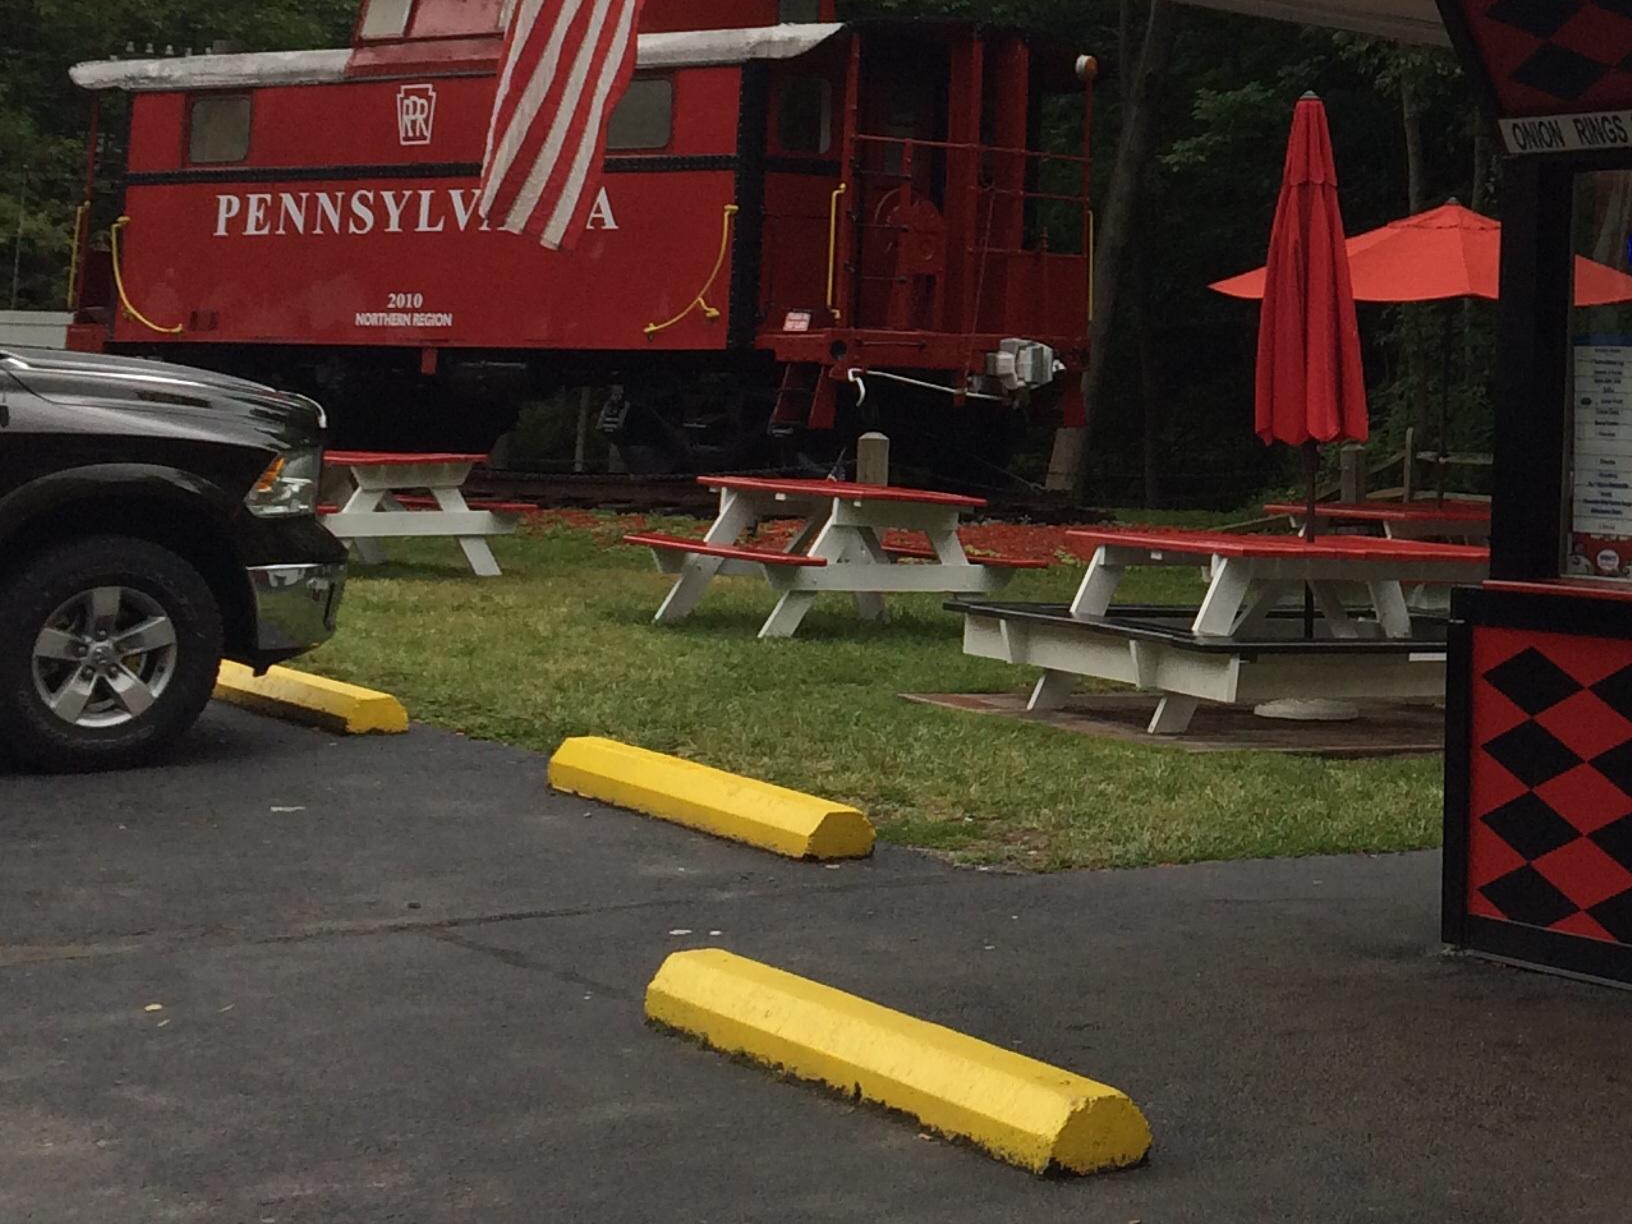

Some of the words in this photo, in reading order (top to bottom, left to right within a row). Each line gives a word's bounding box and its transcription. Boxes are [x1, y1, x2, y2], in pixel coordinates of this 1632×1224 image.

[1512, 120, 1566, 150] ONION
[212, 186, 619, 237] PENNSYLVA
[386, 292, 424, 309] 2010
[354, 312, 411, 326] NORTHERN
[412, 312, 453, 327] REGION
